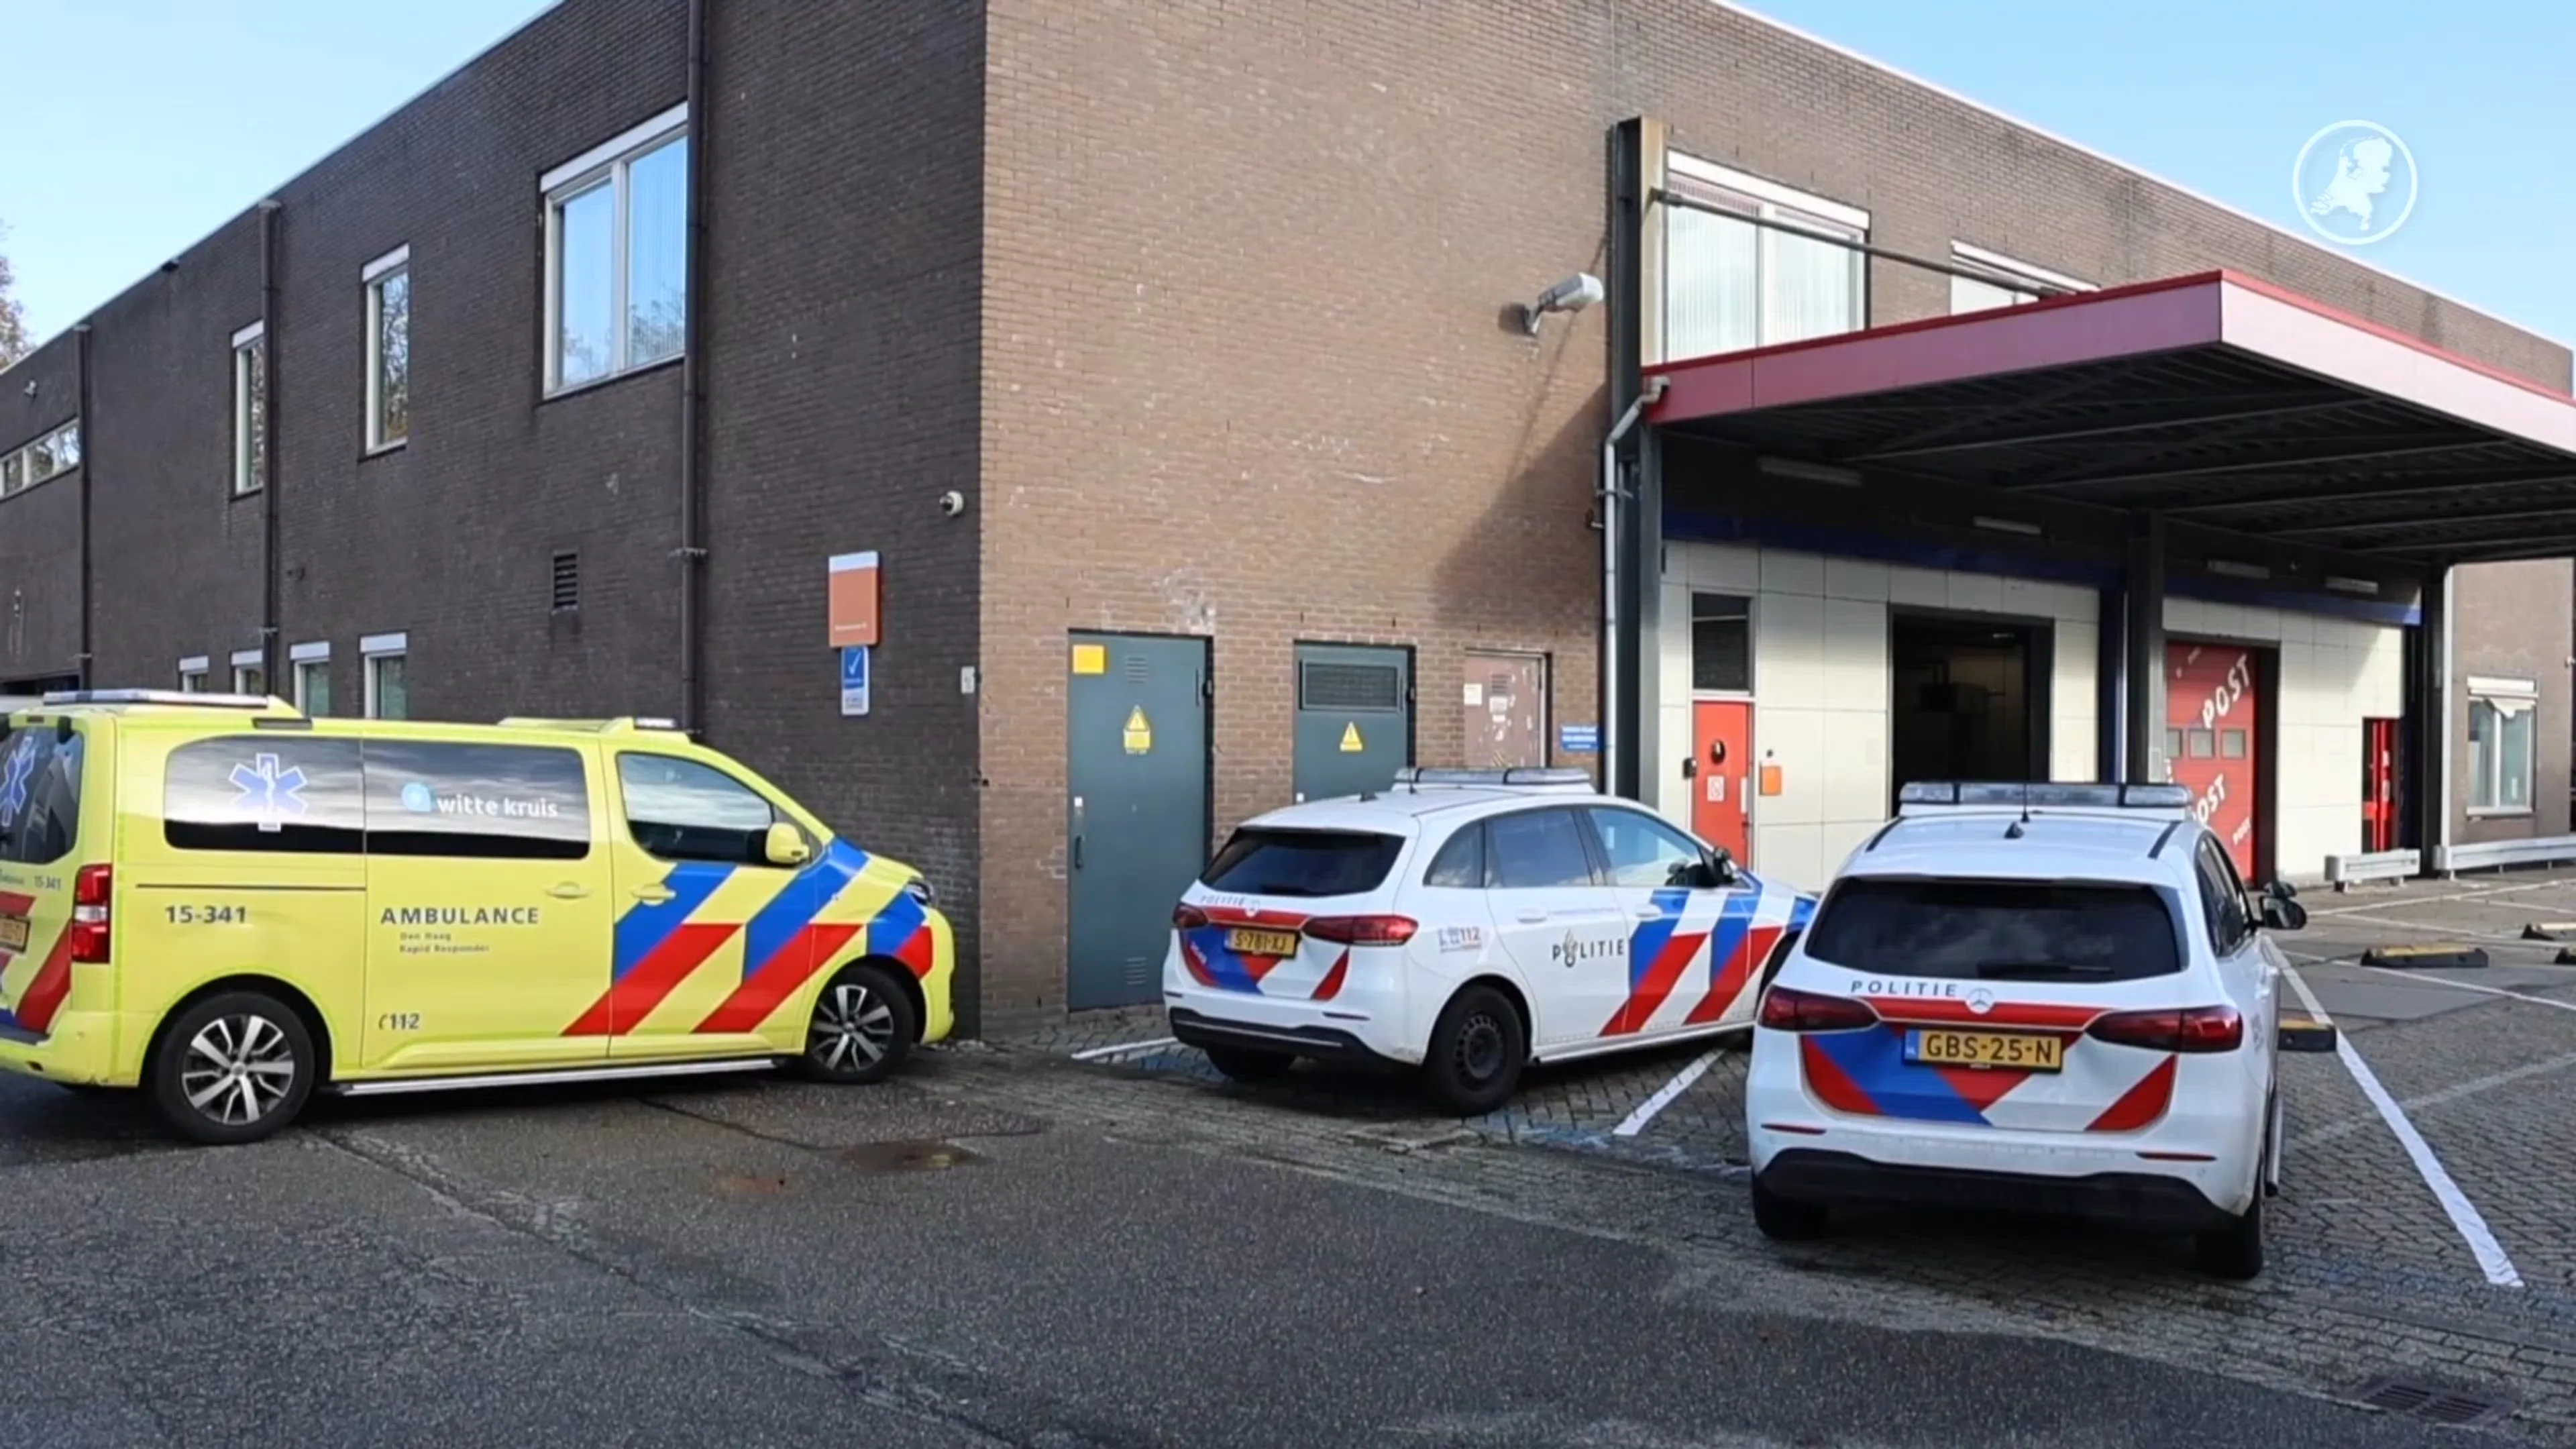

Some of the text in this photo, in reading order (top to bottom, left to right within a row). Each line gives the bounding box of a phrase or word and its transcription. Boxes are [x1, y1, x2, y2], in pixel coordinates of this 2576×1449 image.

[2202, 652, 2250, 729] POST
[438, 794, 558, 818] witte kruis
[2192, 772, 2225, 826] OST
[165, 904, 246, 924] 15-341
[380, 907, 539, 925] AMBULANCE
[400, 932, 421, 941] Den
[399, 944, 490, 954] Rapid Responder
[1851, 980, 1957, 998] POLITIE
[390, 1012, 420, 1030] 112
[1926, 1034, 2053, 1064] GBS-25-N
